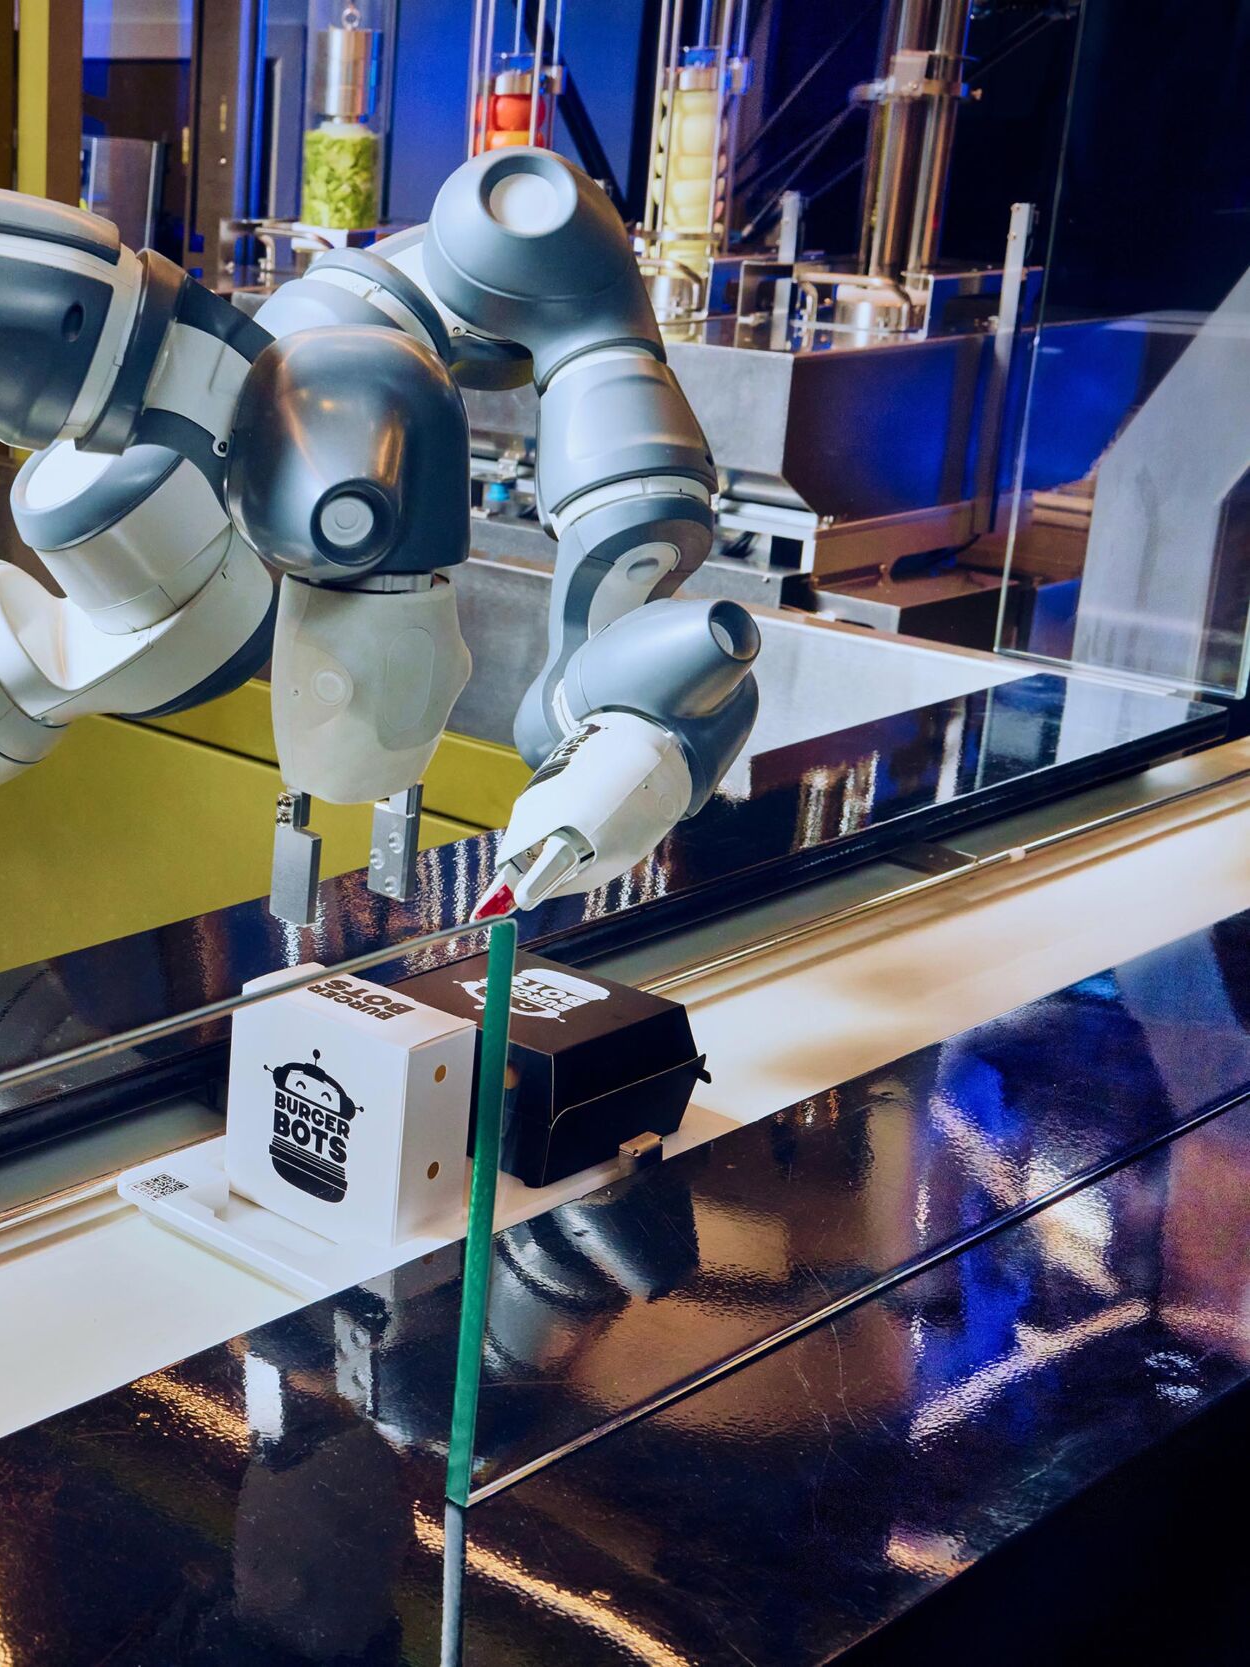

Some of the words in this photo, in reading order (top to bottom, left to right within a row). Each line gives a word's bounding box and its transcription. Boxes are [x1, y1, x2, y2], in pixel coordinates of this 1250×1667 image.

[307, 984, 396, 1020] BURGER
[324, 980, 416, 1015] BOTS
[275, 1091, 350, 1139] BURGER
[273, 1109, 347, 1164] BOTS
